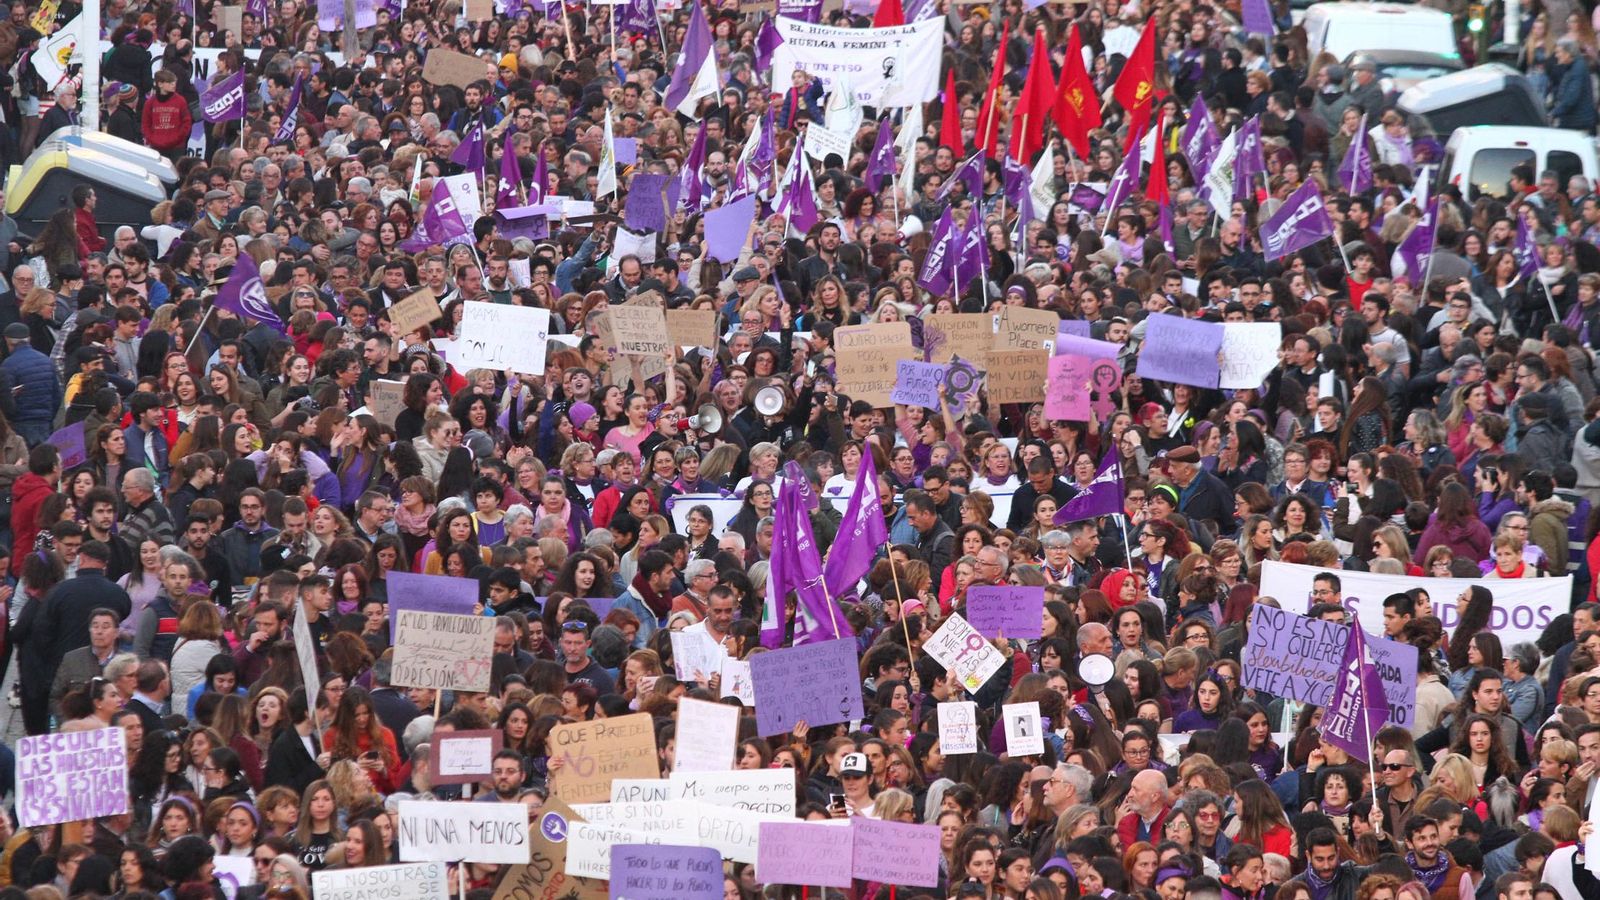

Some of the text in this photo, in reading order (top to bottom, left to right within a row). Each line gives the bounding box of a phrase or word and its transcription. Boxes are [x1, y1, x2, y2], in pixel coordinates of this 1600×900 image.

[901, 26, 917, 35] LA
[788, 37, 837, 49] HUELGA
[999, 304, 1010, 331] A
[1008, 331, 1038, 350] Place
[900, 363, 934, 379] POR UN
[1009, 370, 1041, 381] VIDA
[1256, 605, 1348, 645] NO ES NO
[1254, 625, 1277, 651] SI
[1287, 635, 1345, 665] QUIERES
[394, 664, 455, 687] OPRESIÓN
[1243, 663, 1281, 694] VETE
[1281, 675, 1296, 700] A
[19, 728, 119, 758] DISCULPE
[557, 727, 587, 746] QUE
[20, 746, 125, 779] LAS MOLESTIAS
[560, 744, 595, 778] NO
[24, 767, 124, 801] NOS ESTÁN
[681, 780, 705, 799] Mi
[714, 783, 750, 797] cuerpo
[758, 785, 770, 793] es
[22, 788, 126, 824] ASESINANDO
[625, 805, 638, 820] SI
[643, 803, 663, 819] NO
[400, 816, 525, 848] NI UNA MENOS
[578, 826, 632, 843] CONTRA
[643, 817, 686, 832] NADIE
[318, 863, 439, 890] SI NOSOTRAS
[418, 881, 440, 895] SE
